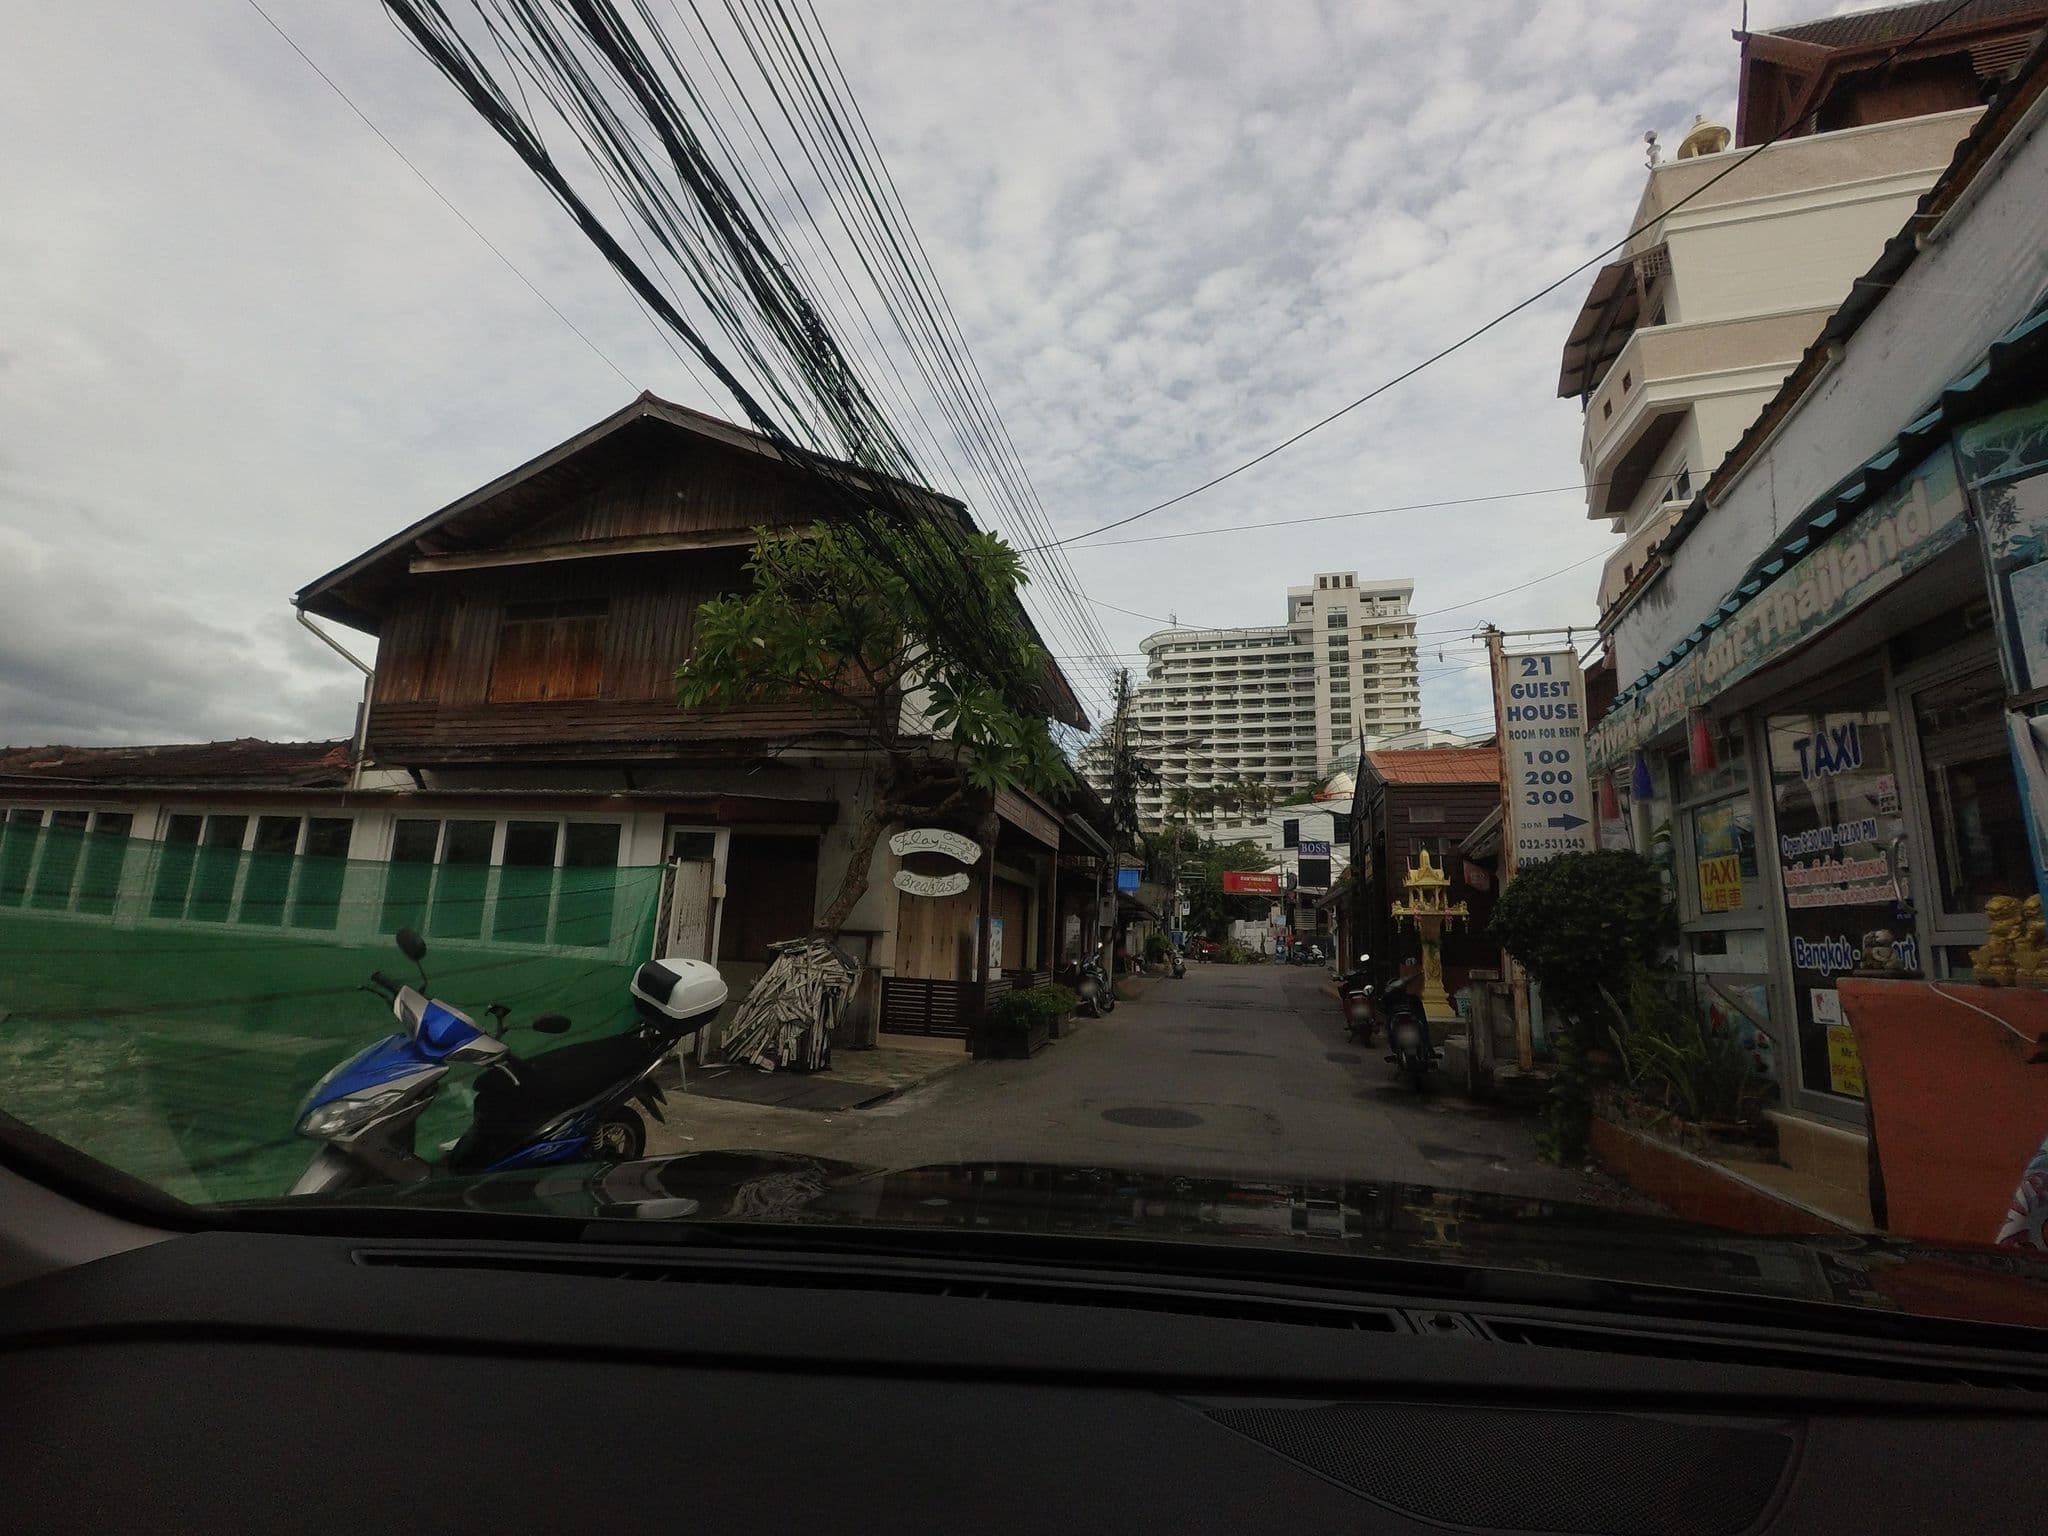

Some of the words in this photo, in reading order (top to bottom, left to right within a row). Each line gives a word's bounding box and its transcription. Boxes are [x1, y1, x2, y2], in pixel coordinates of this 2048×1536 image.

[1752, 477, 1933, 646] Thailand
[1520, 656, 1553, 677] 21
[1511, 681, 1571, 700] GUEST
[1506, 703, 1579, 722] HOUSE
[1508, 729, 1537, 741] ROOM
[1538, 728, 1557, 739] FOR
[1558, 726, 1581, 738] RENT
[1524, 749, 1570, 765] 100
[1792, 720, 1862, 781] TAXI
[1524, 770, 1573, 786] 200
[1526, 790, 1574, 806] 300
[1519, 838, 1586, 850] 032-531243
[1781, 834, 1802, 859] Open
[1818, 826, 1834, 849] AM
[1861, 816, 1879, 841] PM
[1301, 842, 1328, 853] BOSS
[1700, 858, 1738, 886] TAXI
[901, 874, 961, 895] Breakfast
[1793, 934, 1853, 977] Bangkok
